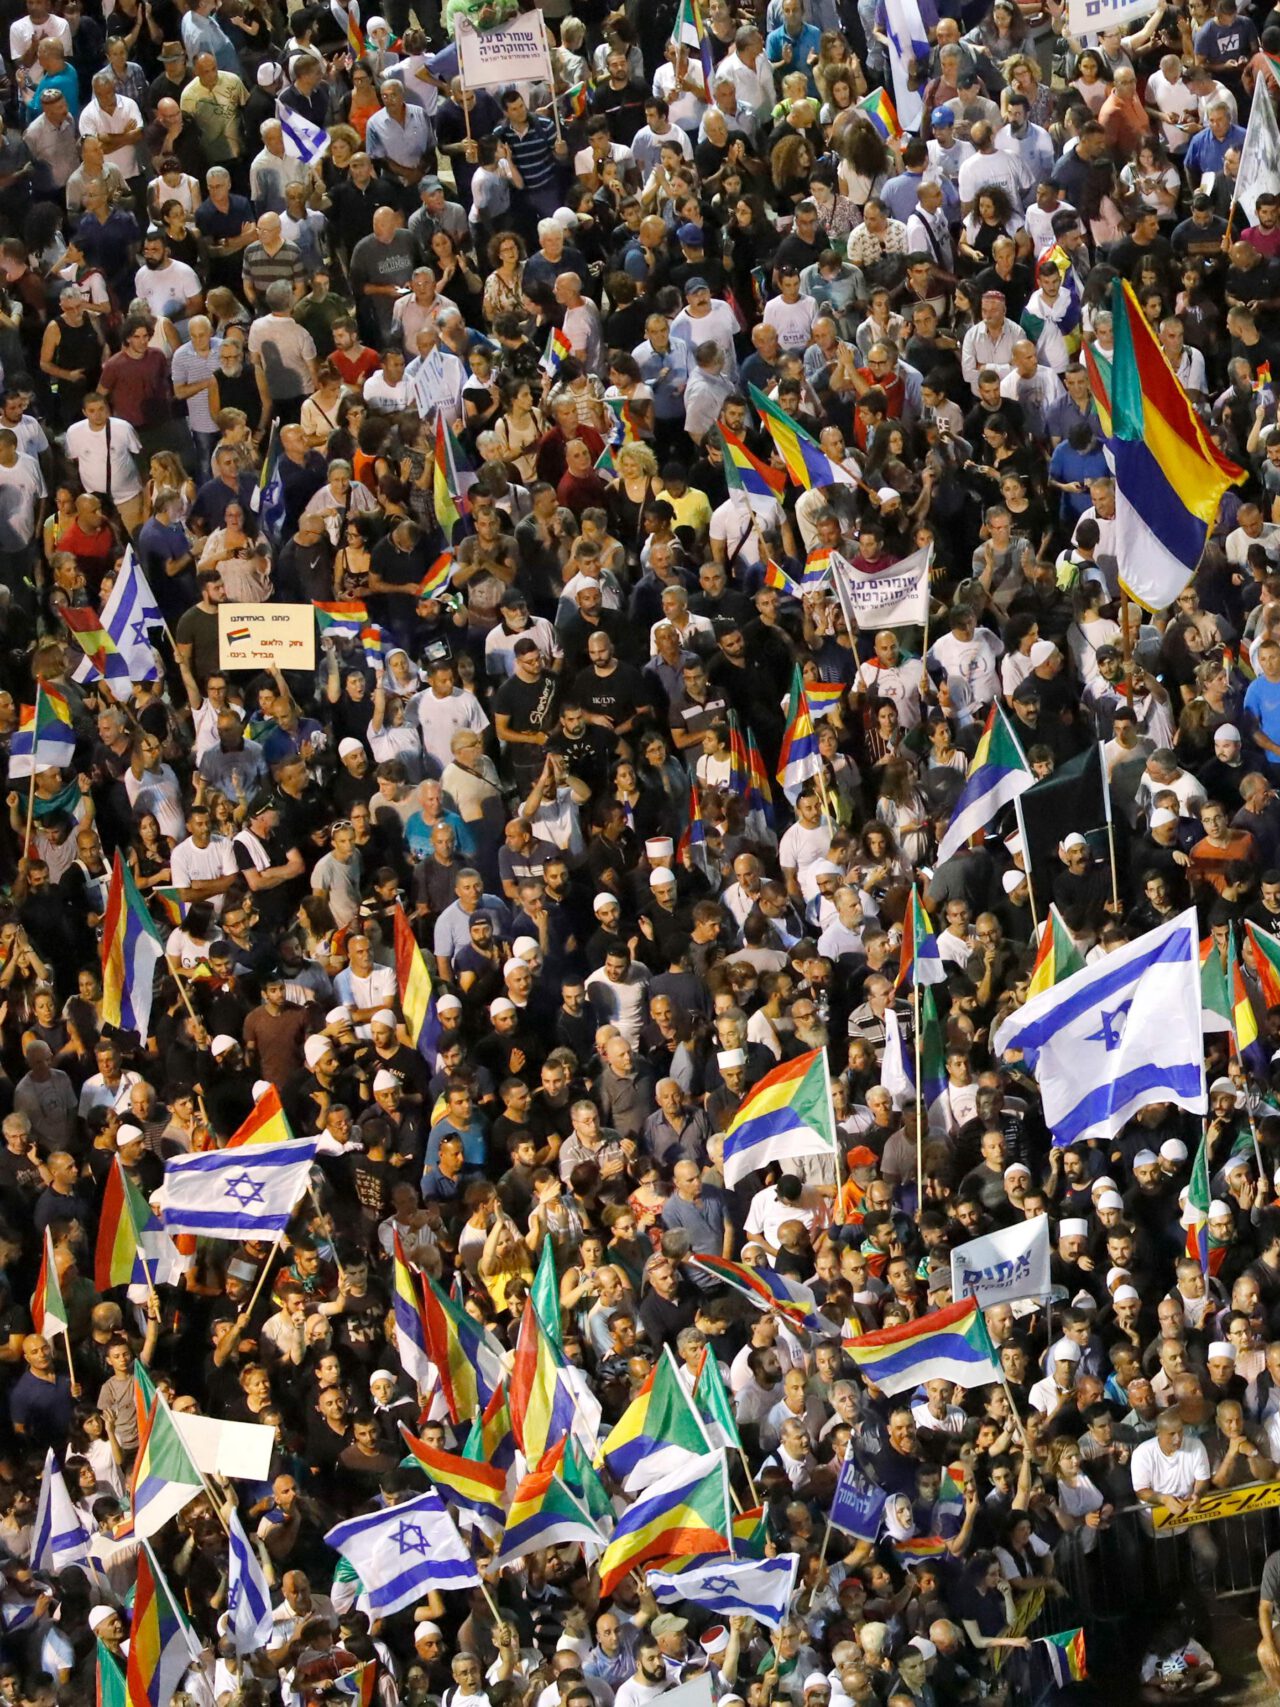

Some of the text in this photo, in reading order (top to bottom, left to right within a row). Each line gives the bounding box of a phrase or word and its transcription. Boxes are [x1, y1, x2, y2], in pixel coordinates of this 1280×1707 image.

[495, 31, 533, 43] שומרים
[479, 43, 538, 56] הדמוקרטיה
[849, 578, 865, 591] על
